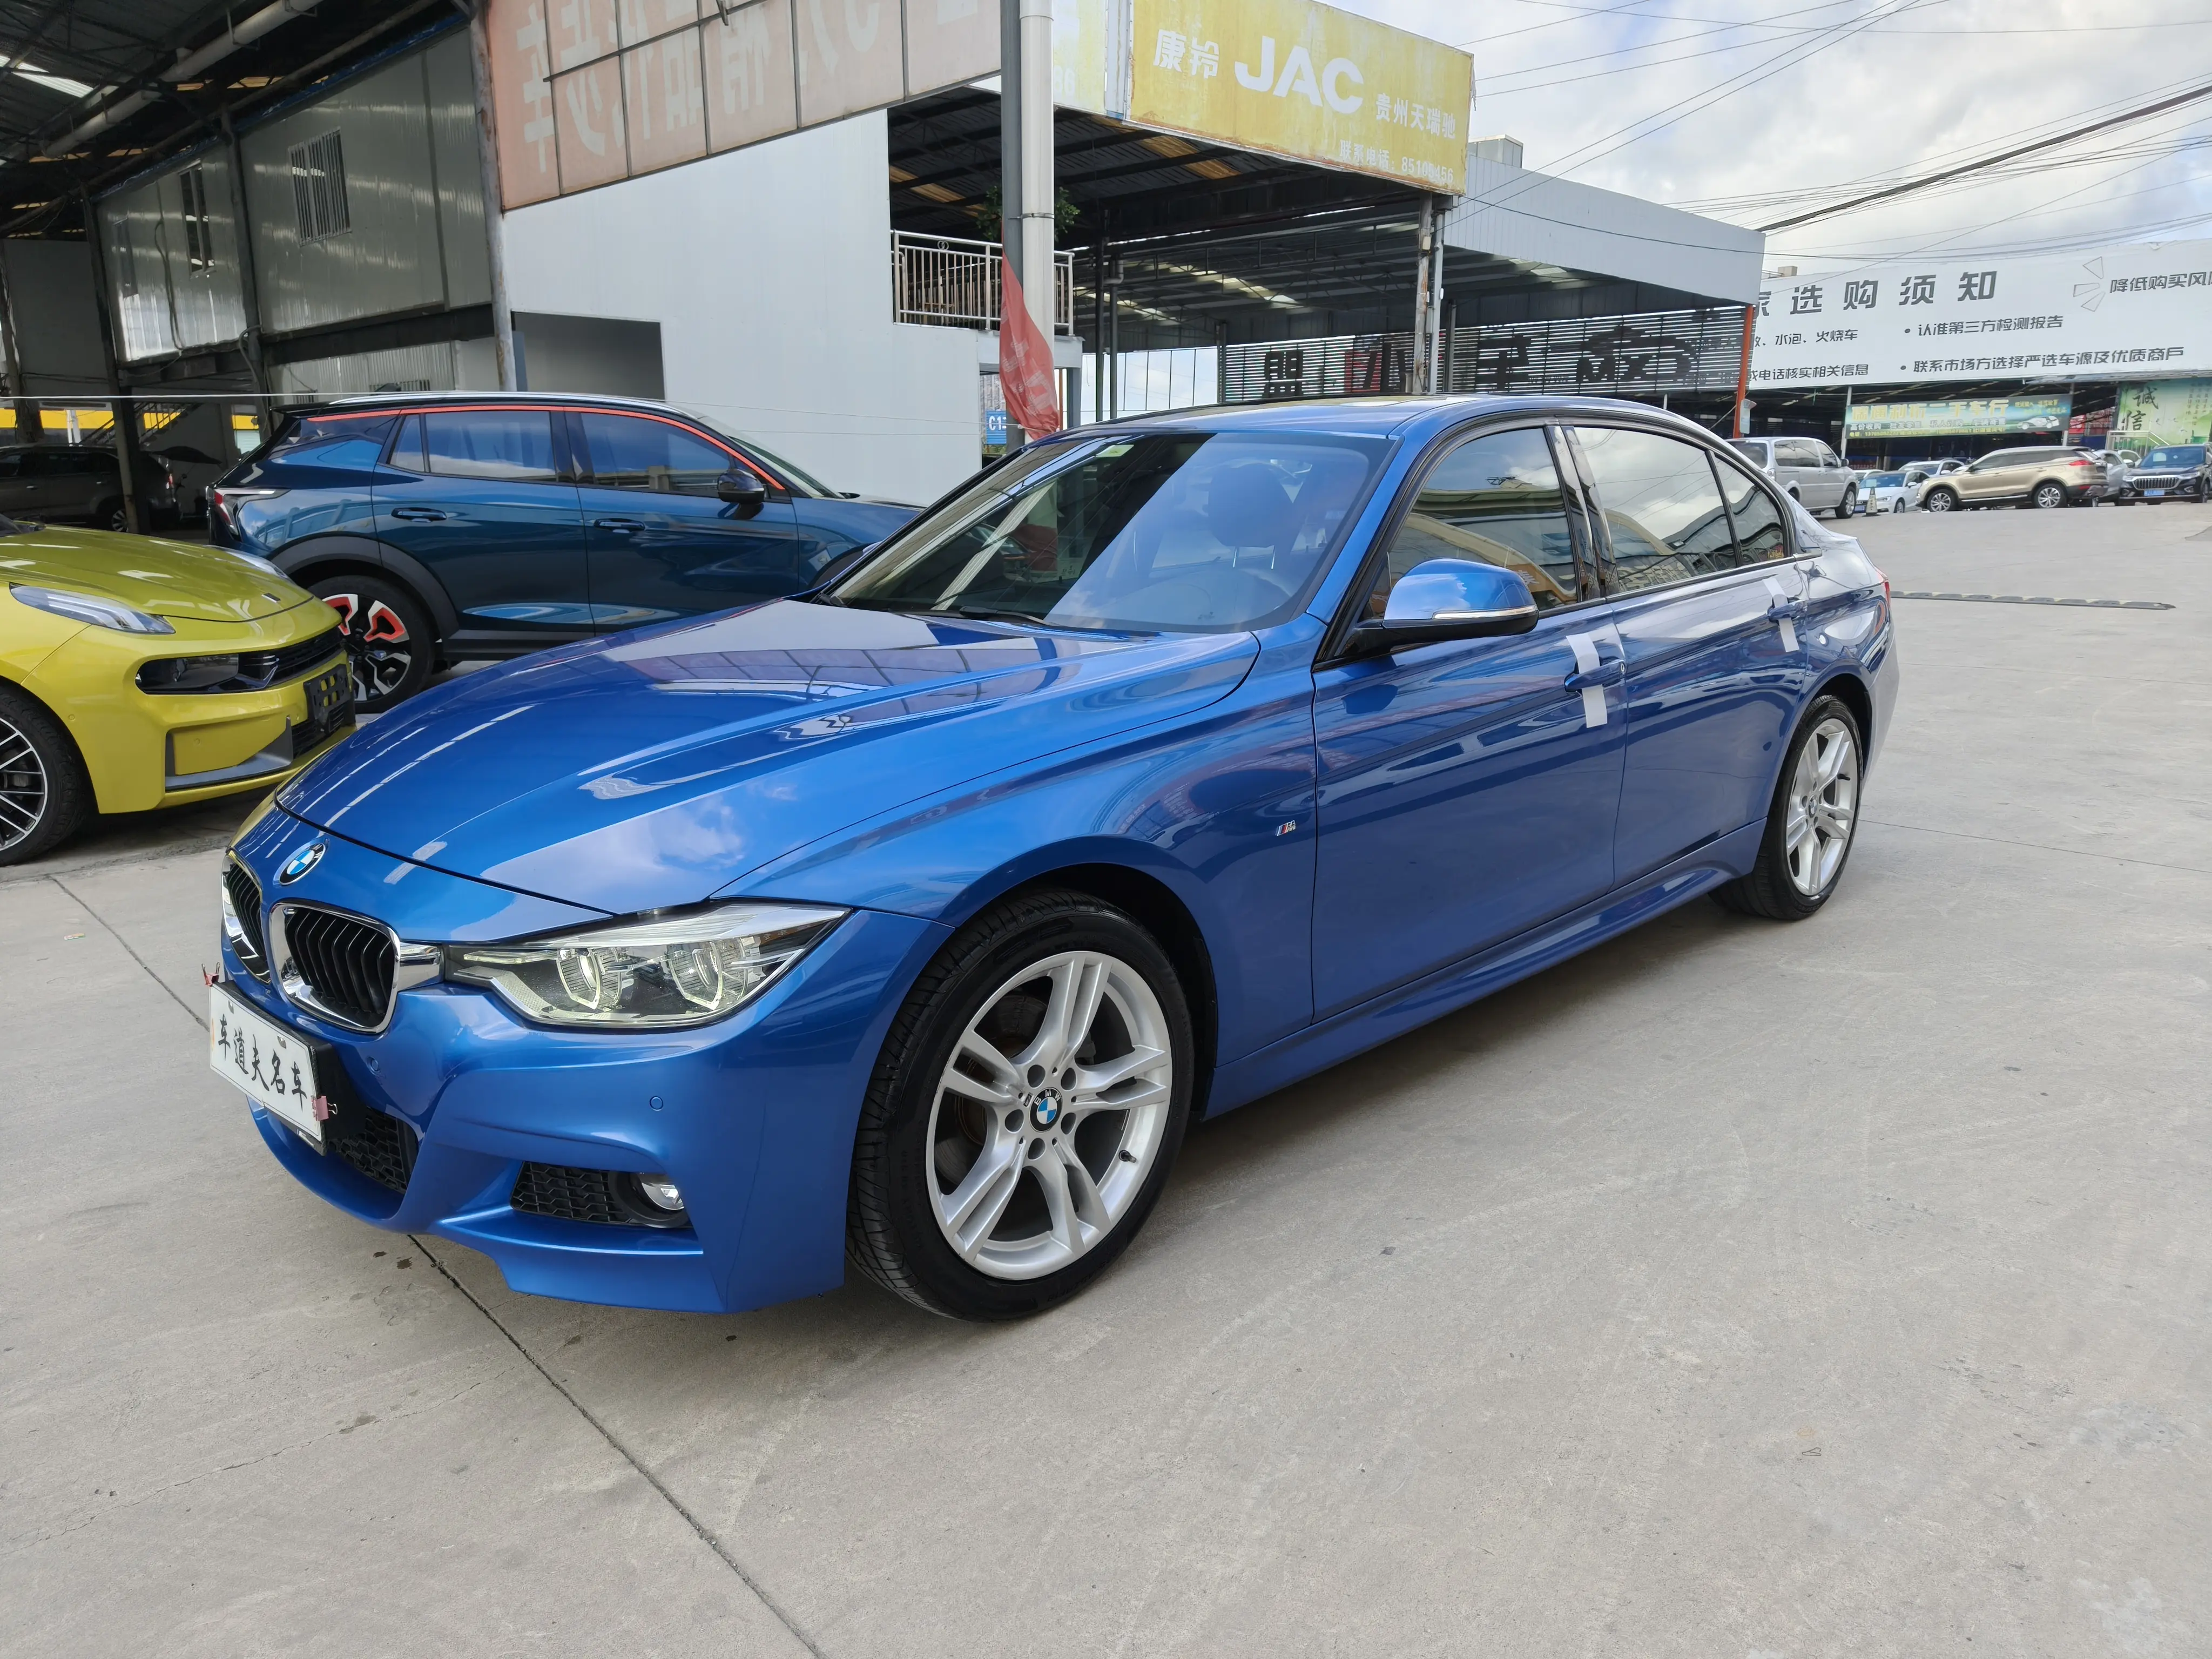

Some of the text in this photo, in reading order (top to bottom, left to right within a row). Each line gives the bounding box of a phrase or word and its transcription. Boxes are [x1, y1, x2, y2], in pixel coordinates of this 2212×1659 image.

[1152, 29, 1364, 114] 康铃 JAC
[1375, 93, 1456, 139] 贵州天瑞驰
[2109, 271, 2212, 293] 降低购买风
[1918, 315, 2063, 336] 认准第三方检测报告
[1913, 347, 2184, 373] 联系市场方选择严选车源及优质商户
[218, 1014, 308, 1112] 车道夫名车
[1034, 1089, 1061, 1106] BMW
